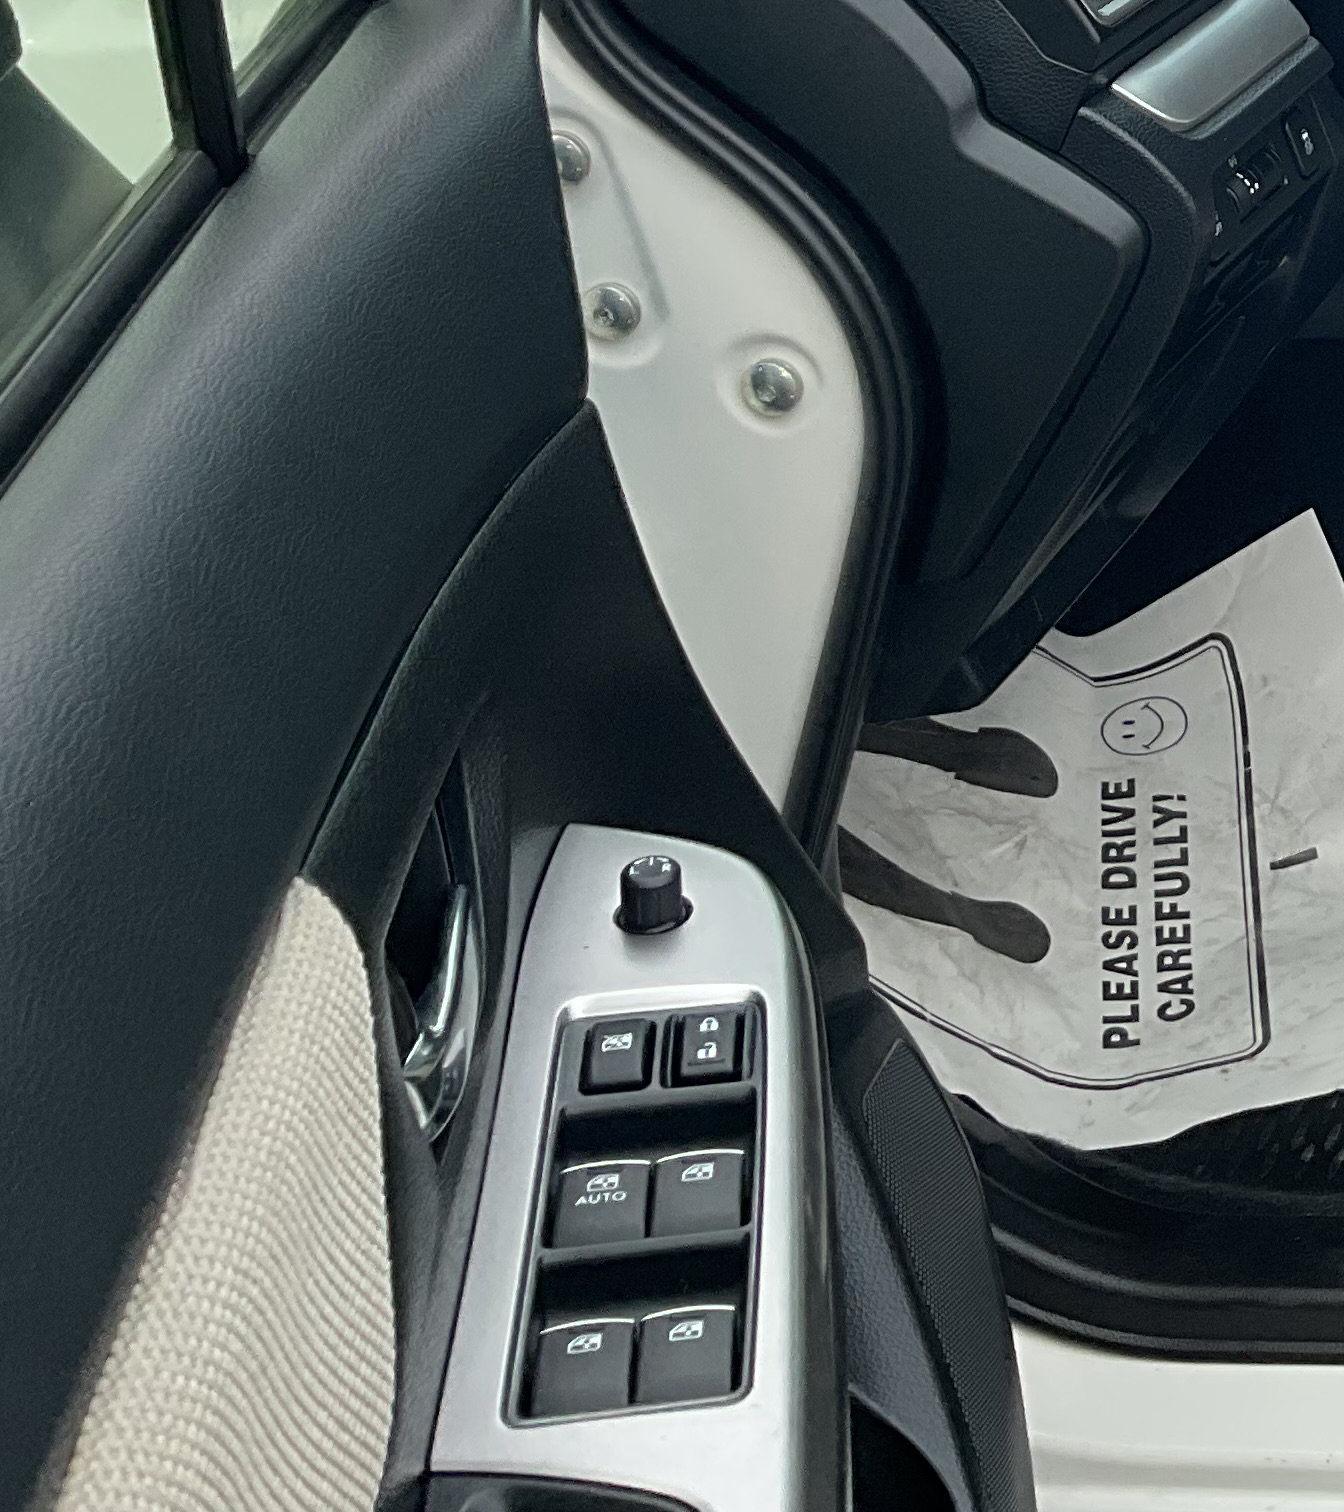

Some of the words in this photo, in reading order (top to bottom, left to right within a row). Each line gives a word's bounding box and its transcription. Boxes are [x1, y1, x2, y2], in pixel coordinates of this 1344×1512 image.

[1101, 777, 1138, 890] DRIVE
[1151, 793, 1196, 1023] CAREFULLY!
[1101, 904, 1141, 1049] PLEASE
[574, 1190, 627, 1206] AUTO
